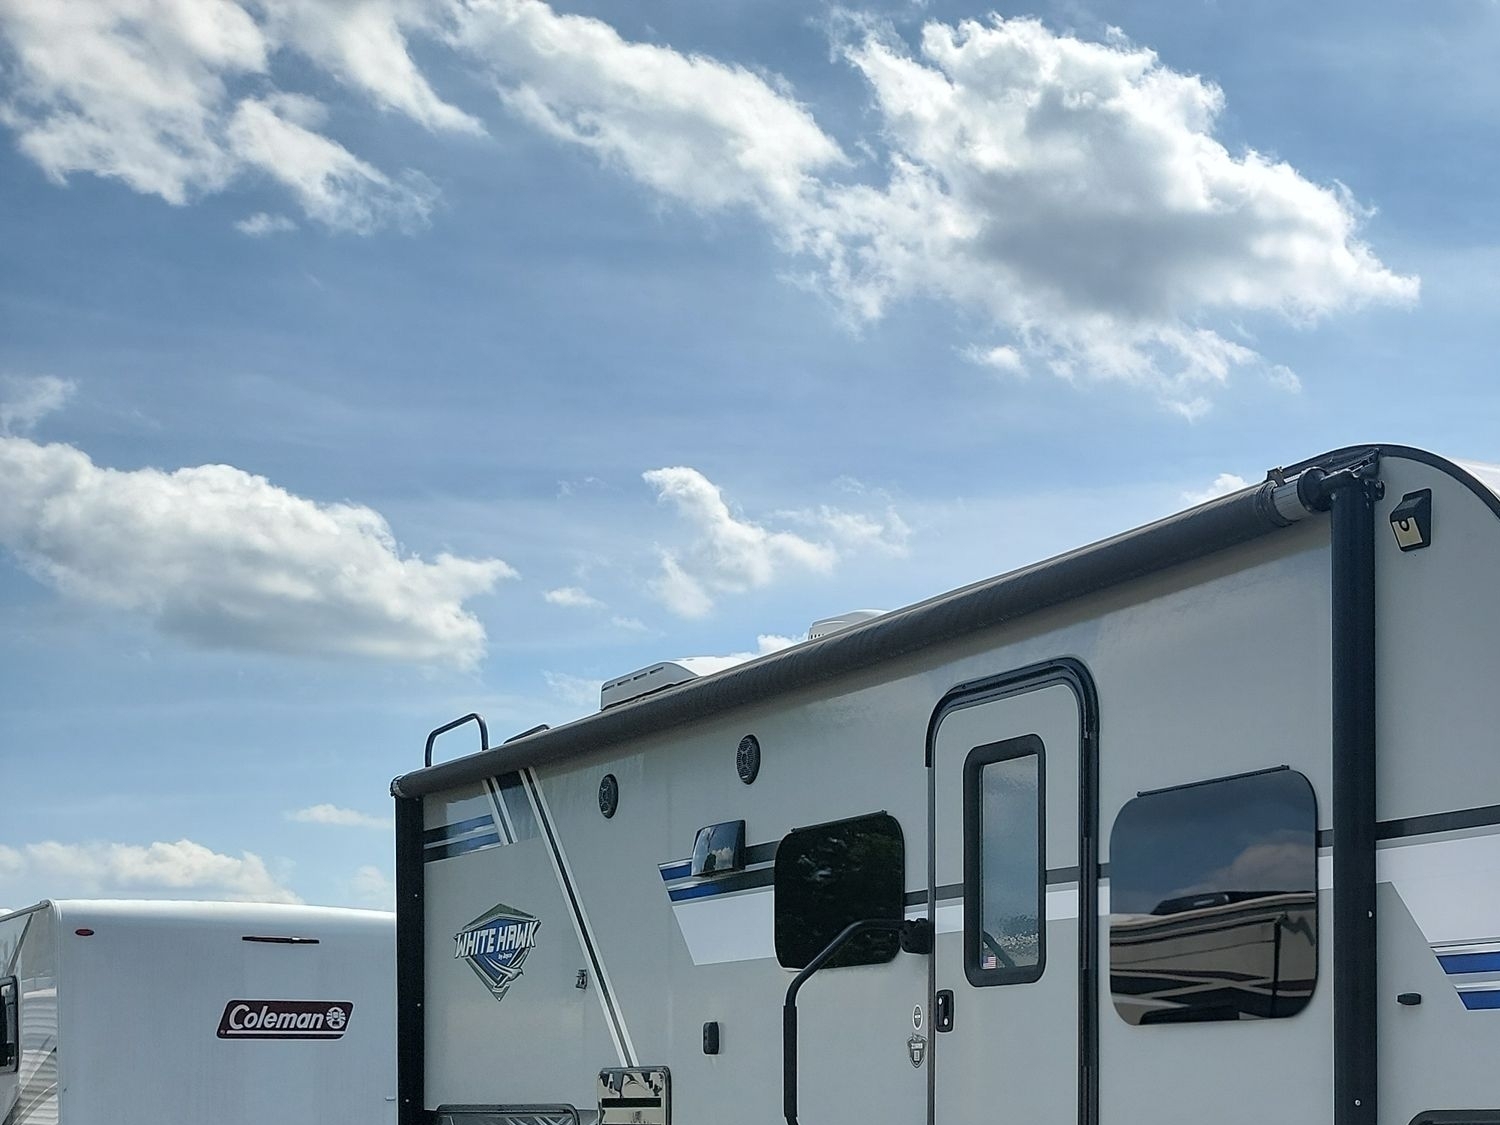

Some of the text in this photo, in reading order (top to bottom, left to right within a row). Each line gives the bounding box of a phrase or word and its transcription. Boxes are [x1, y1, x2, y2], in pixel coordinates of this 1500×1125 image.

[454, 920, 541, 959] WHITE HAWK
[228, 1003, 325, 1030] Coleman
